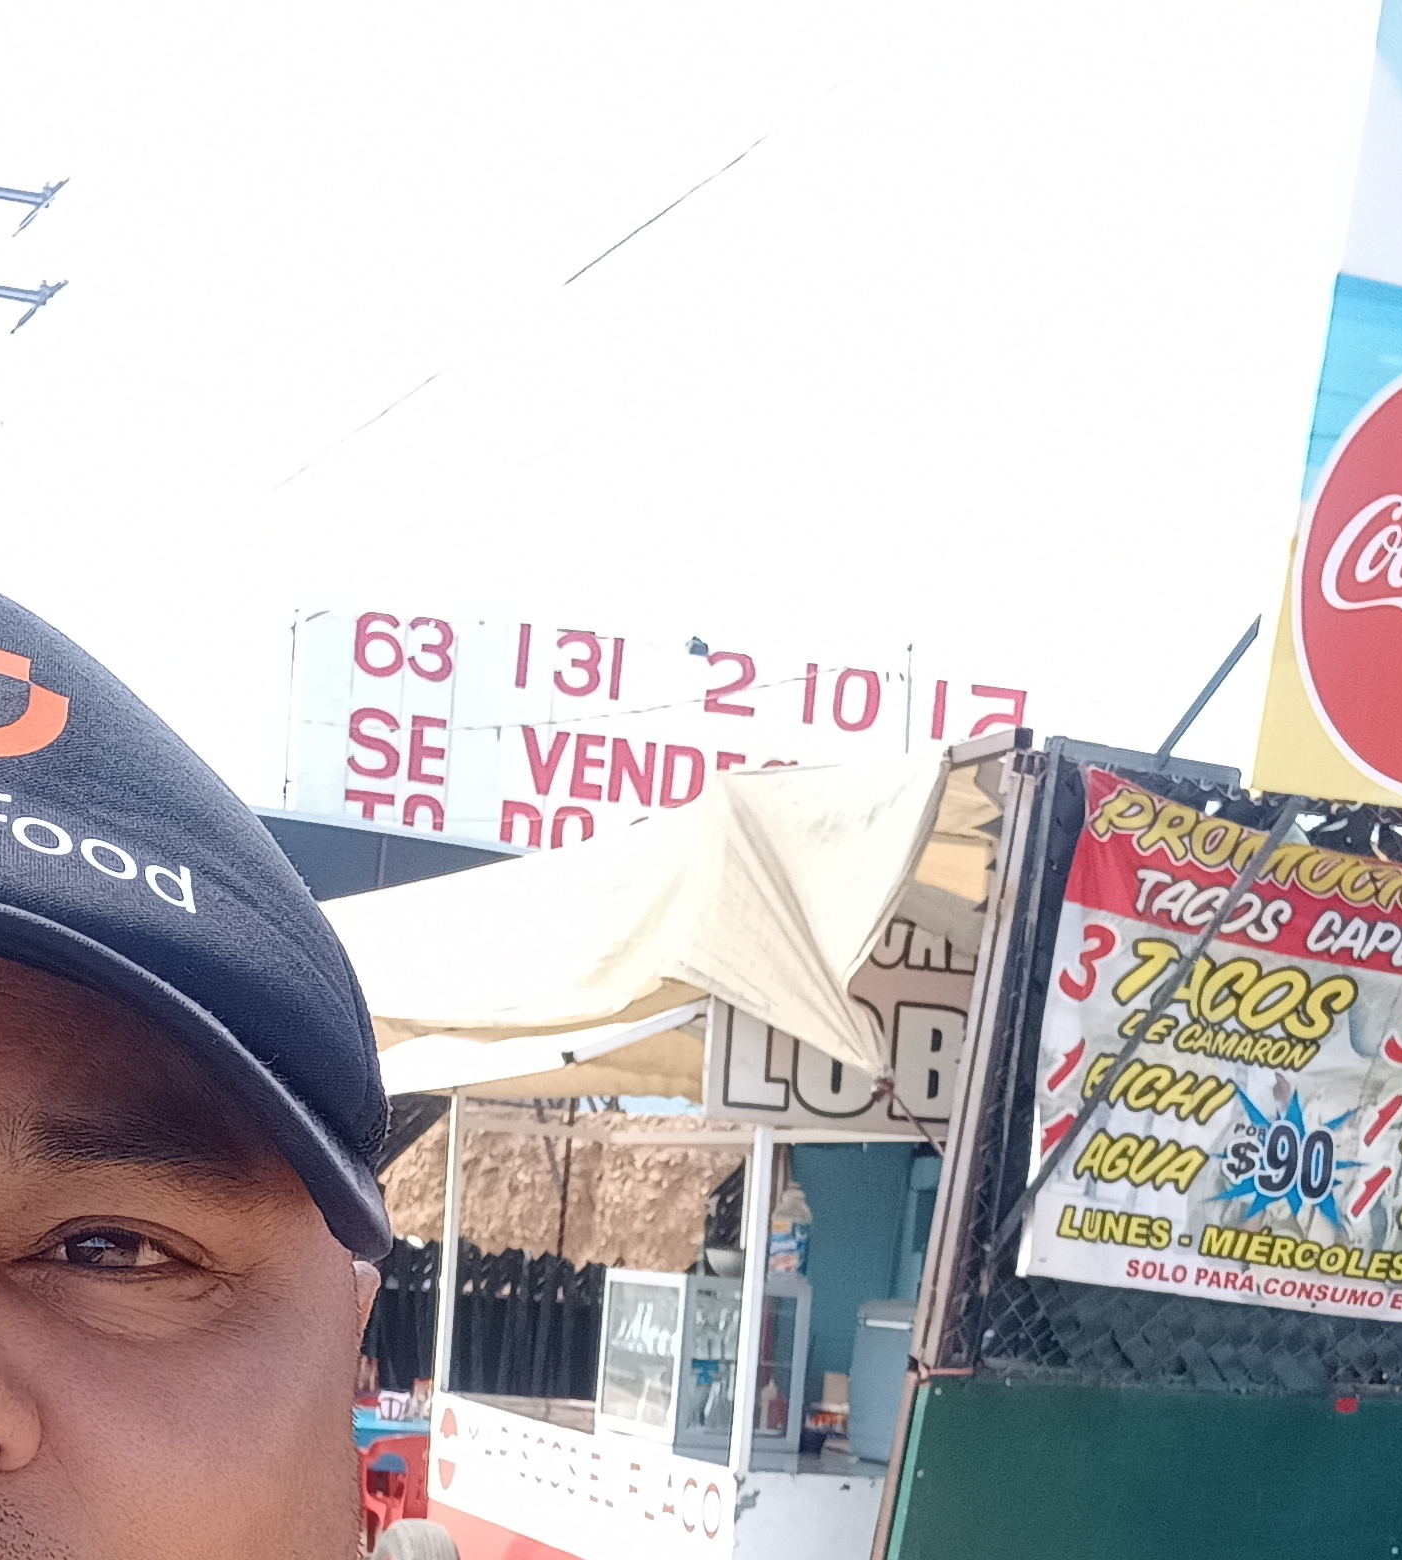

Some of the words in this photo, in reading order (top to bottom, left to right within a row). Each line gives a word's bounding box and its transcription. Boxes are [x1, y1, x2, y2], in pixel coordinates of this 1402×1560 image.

[346, 707, 448, 785] SE
[1135, 868, 1292, 943] TACOS
[1058, 923, 1117, 1001] 3
[1111, 936, 1360, 1041] TACOS
[1046, 1036, 1087, 1092] 1
[1072, 1126, 1210, 1195] AGUA
[1221, 1121, 1339, 1204] $90
[1348, 1163, 1395, 1221] 1
[1055, 1204, 1173, 1251] LUNES
[1125, 1257, 1189, 1285] SOLO
[1194, 1268, 1257, 1293] PARA
[1263, 1275, 1385, 1310] CONSUMO
